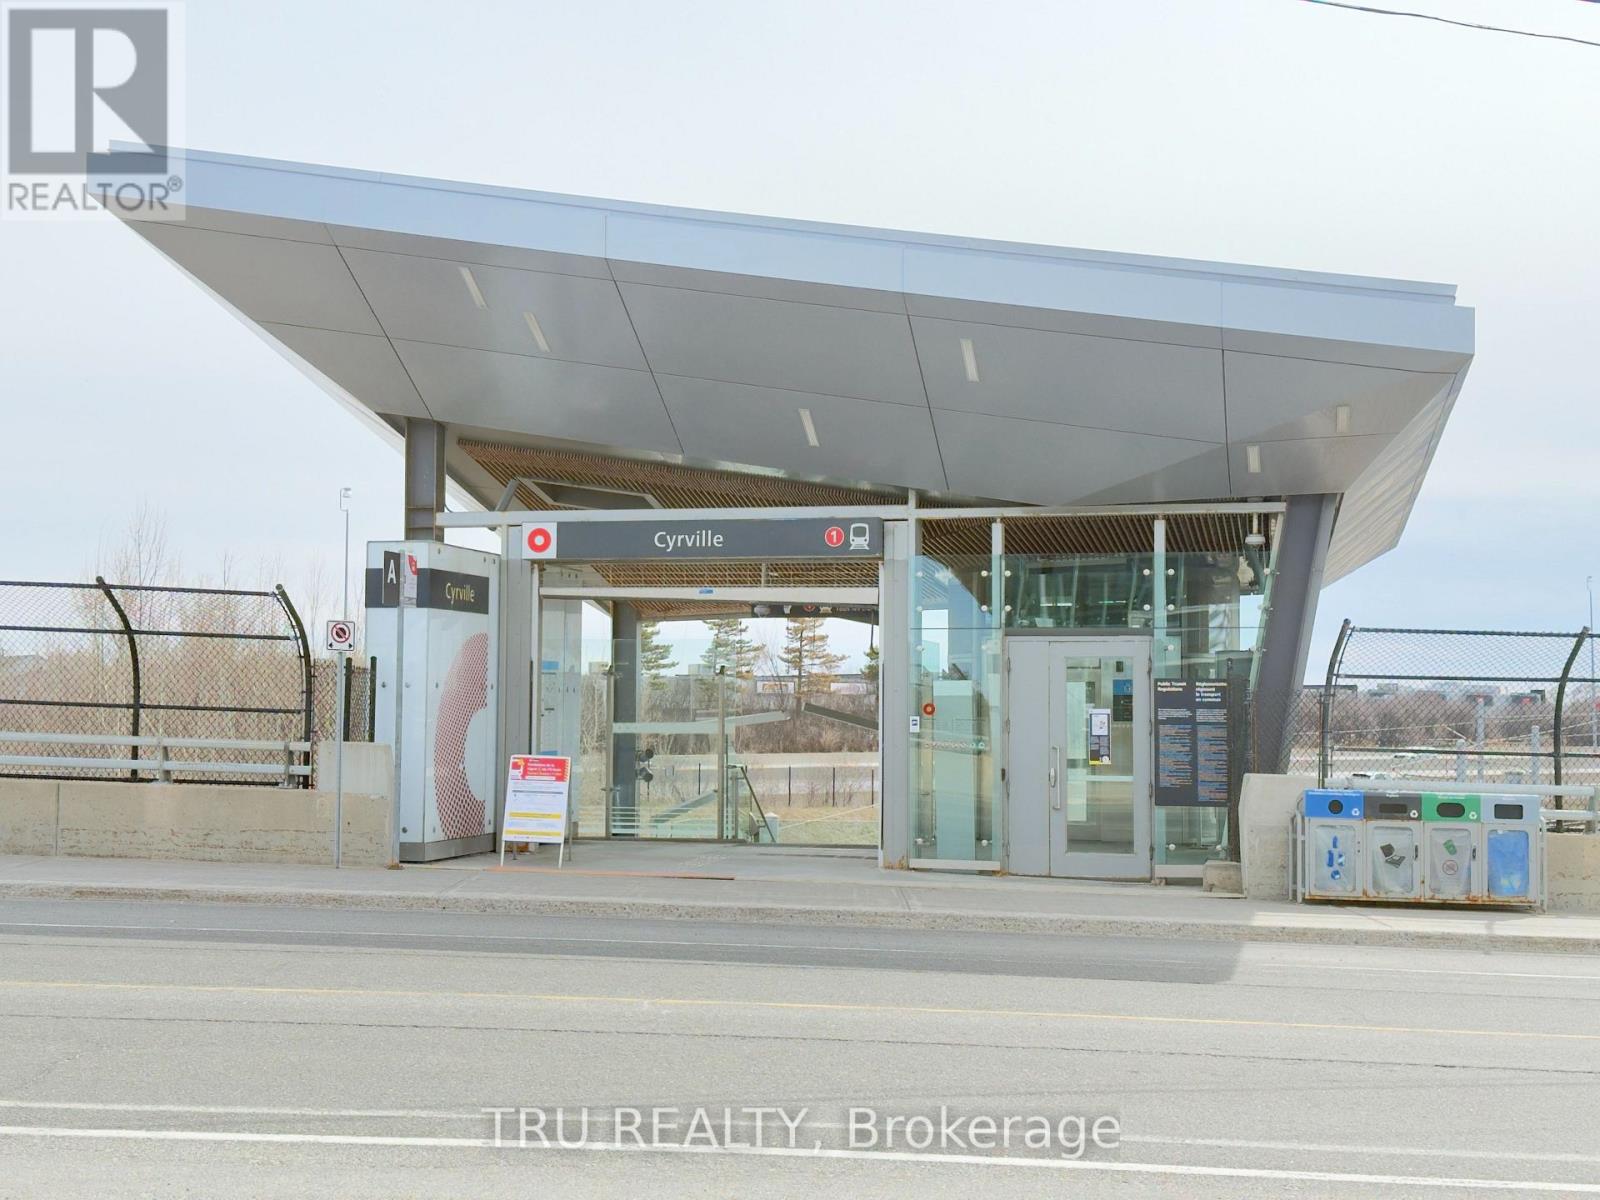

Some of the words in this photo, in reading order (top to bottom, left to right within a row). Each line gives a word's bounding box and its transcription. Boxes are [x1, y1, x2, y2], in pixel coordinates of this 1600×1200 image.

[654, 530, 724, 551] Cyrville
[387, 559, 397, 585] A
[445, 582, 475, 604] Cyrville
